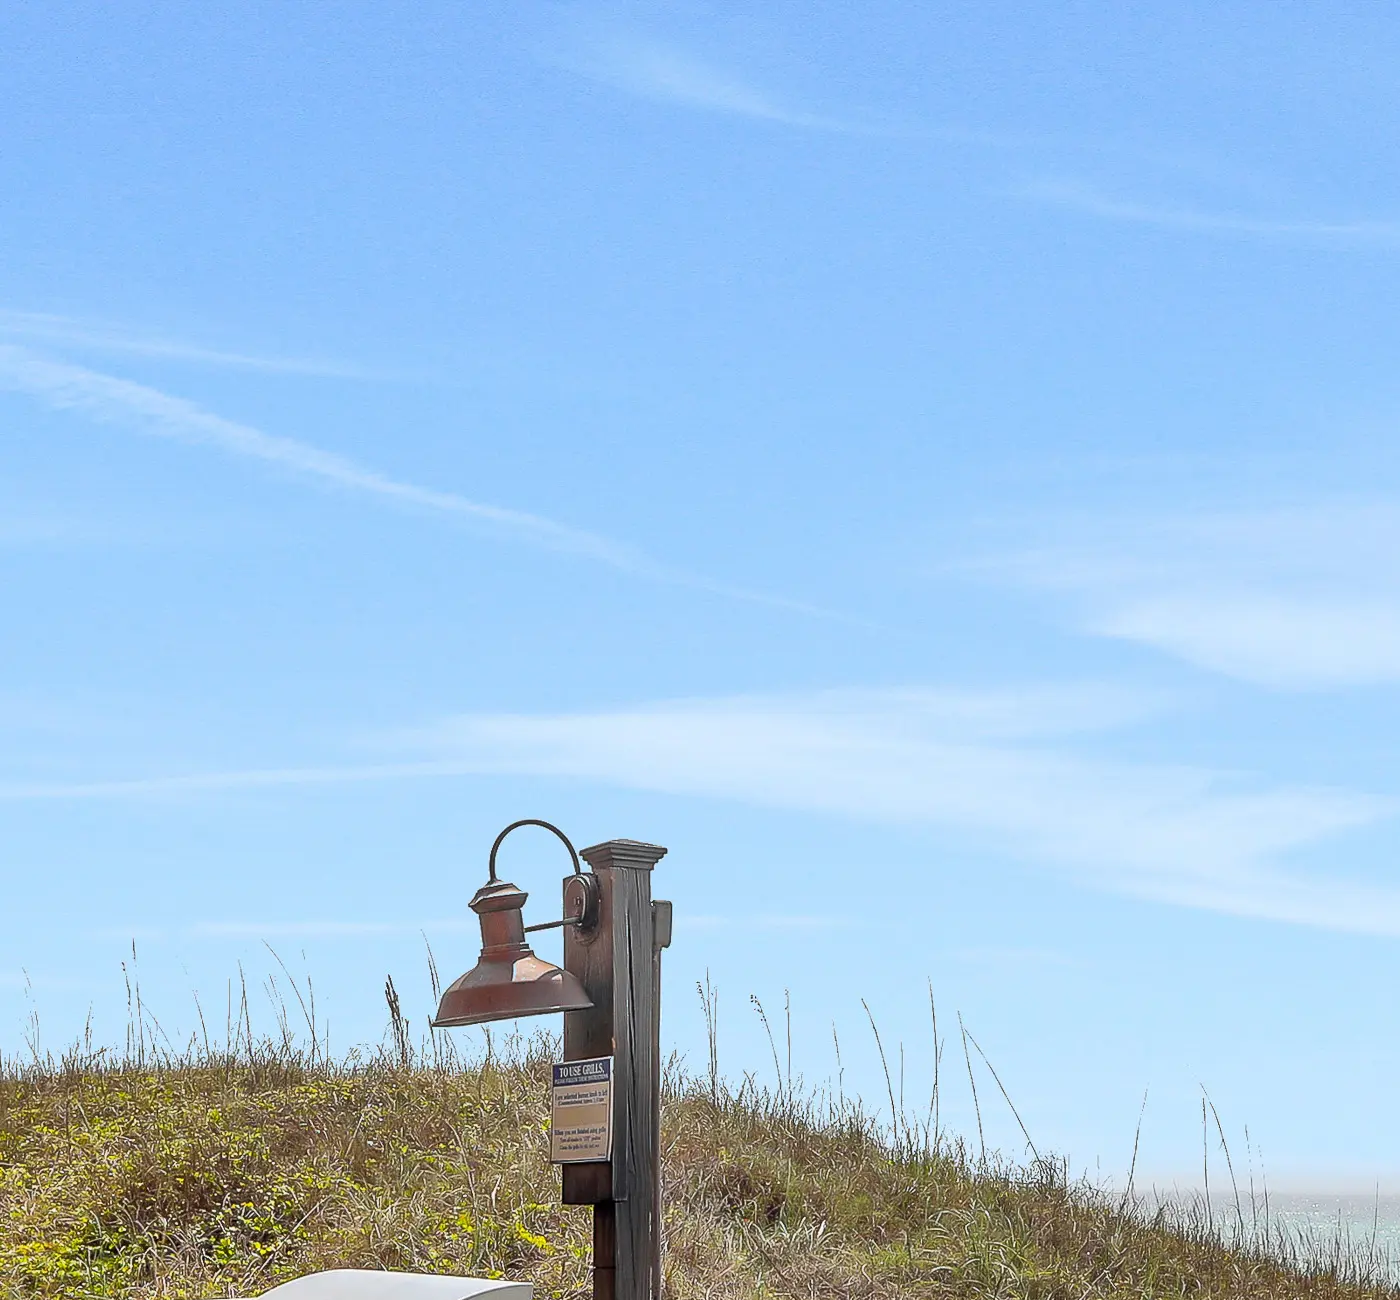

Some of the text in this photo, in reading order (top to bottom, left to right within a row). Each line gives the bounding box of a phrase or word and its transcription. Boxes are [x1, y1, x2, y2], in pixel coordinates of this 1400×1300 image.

[559, 1063, 604, 1078] TO USE GRILLS,
